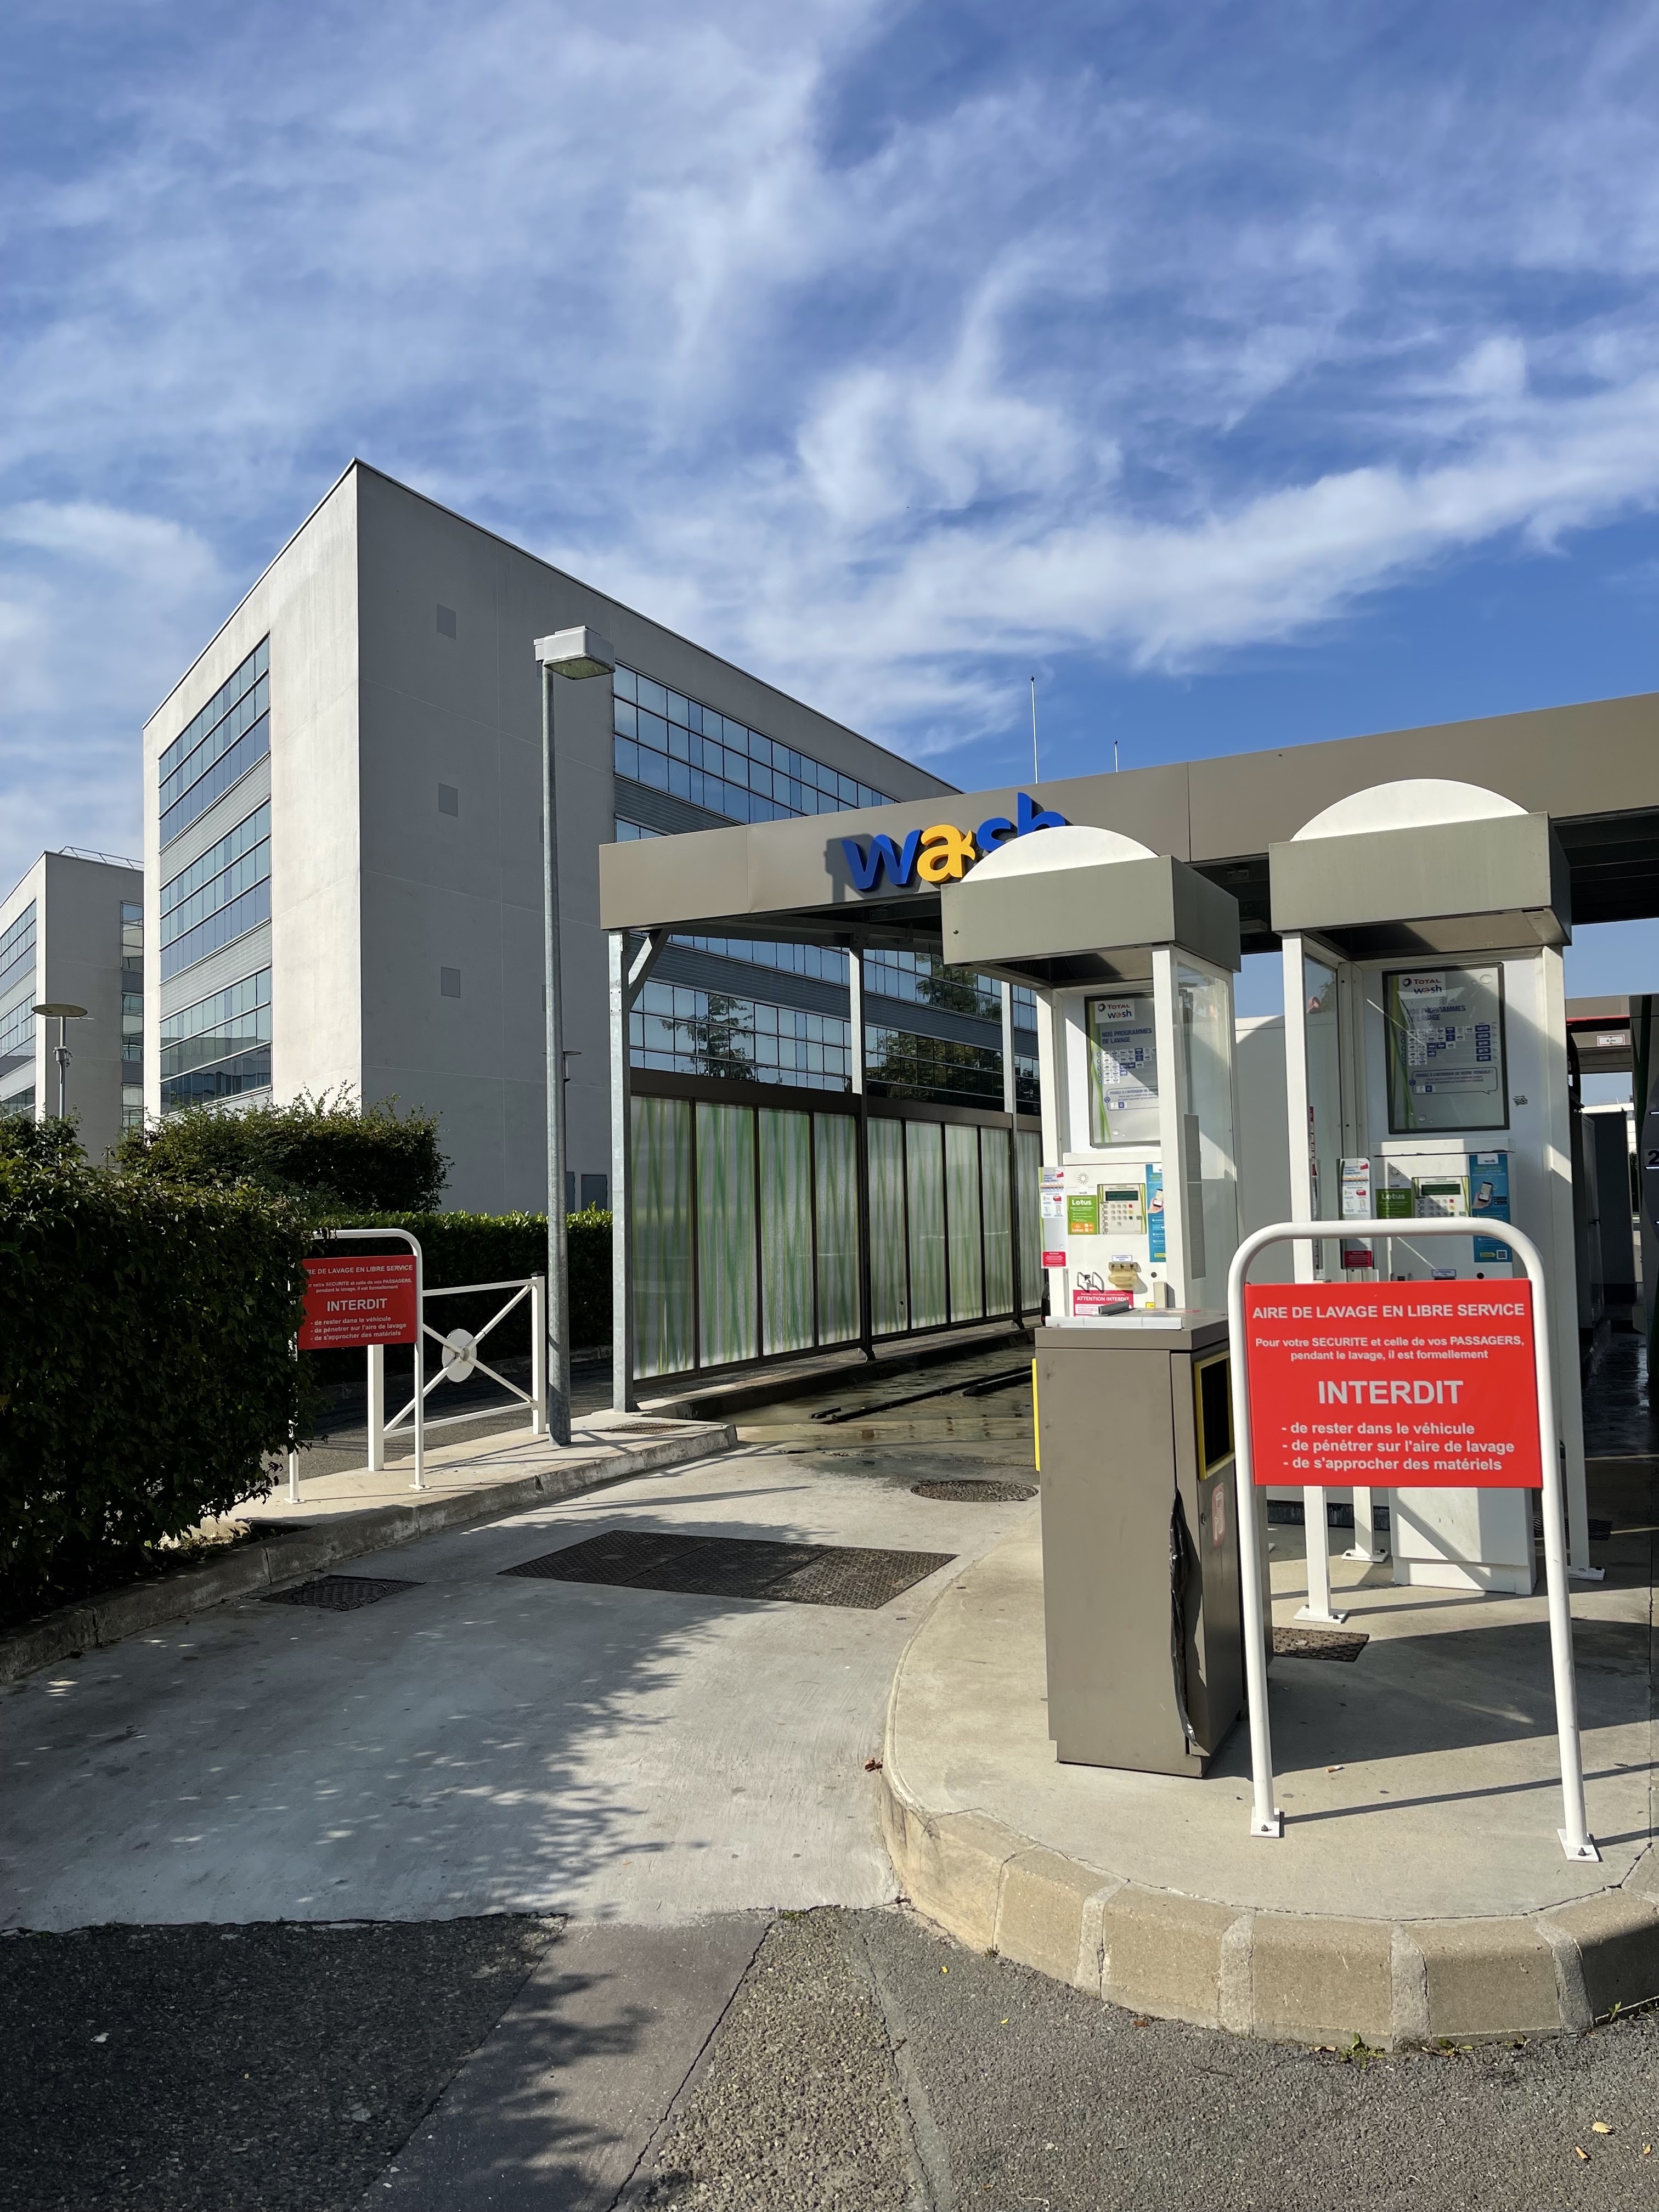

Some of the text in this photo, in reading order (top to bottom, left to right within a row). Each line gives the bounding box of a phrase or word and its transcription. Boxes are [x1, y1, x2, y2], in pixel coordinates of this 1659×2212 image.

[1414, 985, 1442, 994] wash
[1108, 1009, 1132, 1019] wash
[1114, 1028, 1152, 1036] PROGRAMMES
[328, 1299, 387, 1311] INTERDIT
[1252, 1304, 1525, 1318] AIRE DE LAVAGE EN LIBRE SERVICE
[1256, 1338, 1280, 1346] Pour
[1283, 1339, 1309, 1347] votre
[1312, 1338, 1368, 1346] SECURITE
[1384, 1337, 1408, 1346] celle
[1412, 1337, 1425, 1346] de
[1450, 1336, 1524, 1345] PASSAGERS,
[1291, 1350, 1488, 1361] pendant le lavage, il est formellement
[1319, 1381, 1463, 1404] INTERDIT
[1291, 1422, 1307, 1433] de
[1312, 1423, 1353, 1434] rester
[1357, 1423, 1392, 1434] dans
[1397, 1423, 1409, 1434] le
[1413, 1423, 1475, 1434] véhicule
[1291, 1440, 1308, 1451] de
[1313, 1440, 1373, 1453] pénétrer
[1377, 1443, 1401, 1452] sur
[1405, 1440, 1440, 1452] l'aire
[1444, 1441, 1462, 1452] de
[1466, 1441, 1514, 1455] lavage
[1293, 1457, 1310, 1468] de
[1314, 1457, 1399, 1471] s'approcher
[1403, 1458, 1429, 1470] des
[1434, 1458, 1502, 1470] matériels
